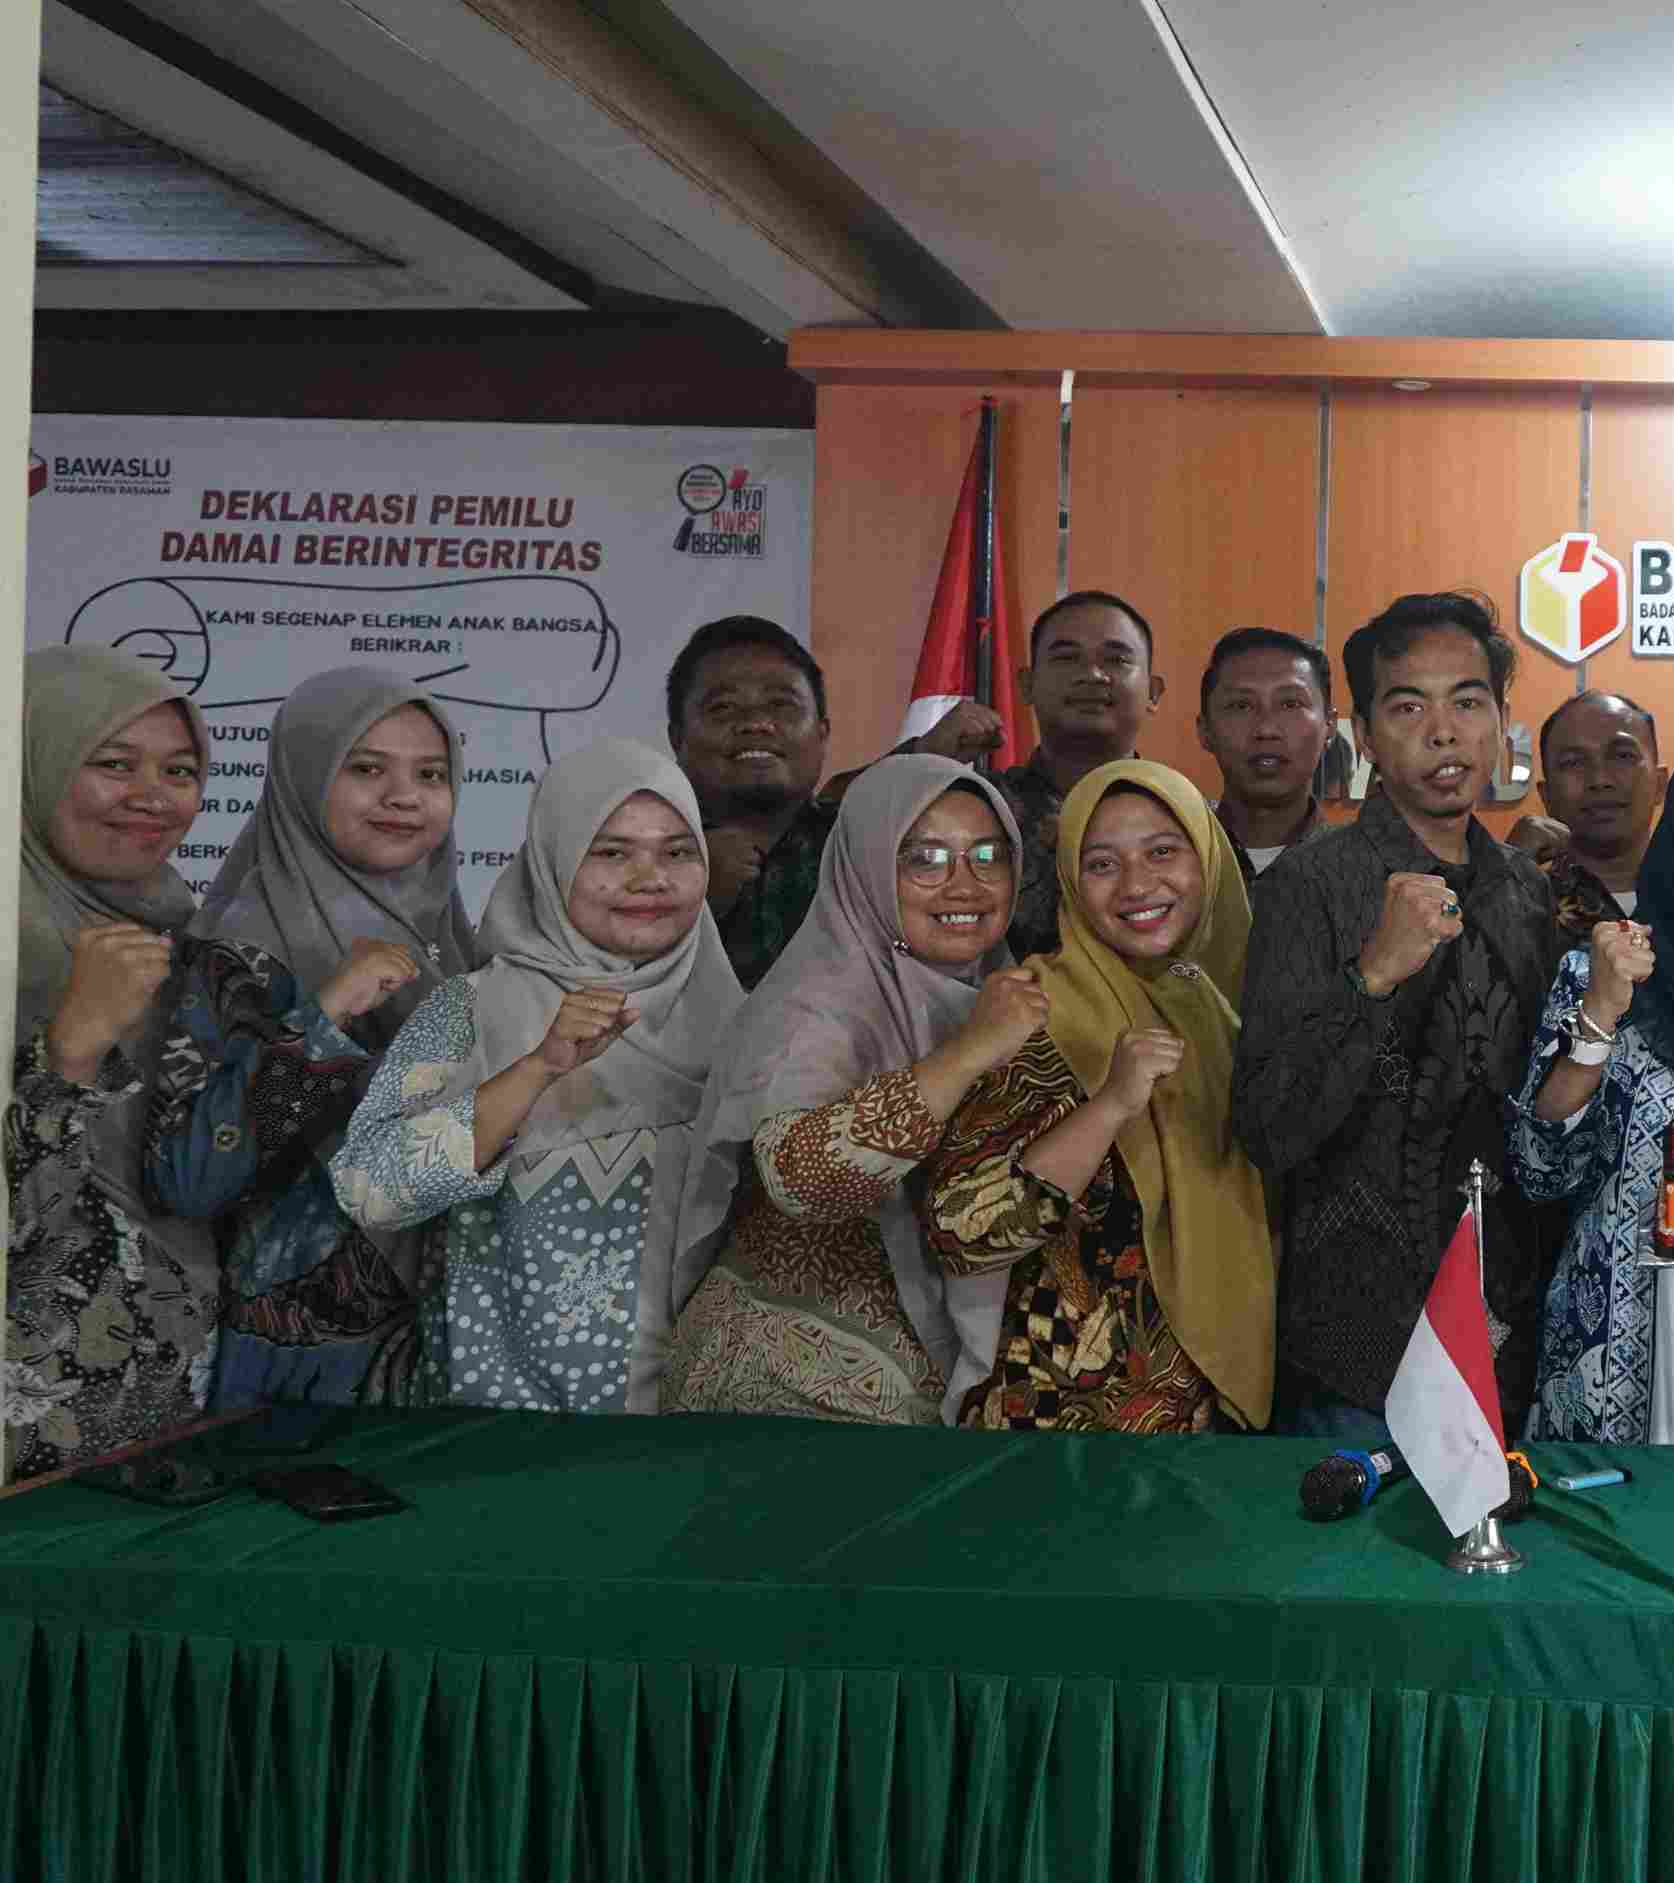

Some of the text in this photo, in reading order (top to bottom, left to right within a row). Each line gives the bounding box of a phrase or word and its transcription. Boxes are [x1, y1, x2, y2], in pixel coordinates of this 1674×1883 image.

[54, 457, 171, 477] BAWASLU
[200, 489, 575, 528] DEKLARASI PEMILU
[733, 488, 762, 511] AYO
[711, 511, 762, 533] AWASI
[160, 531, 603, 572] DAMAI BERINTEGRITAS
[692, 533, 761, 555] BERSAMA
[205, 610, 255, 625] KAMI
[262, 611, 356, 628] SEGENAP
[362, 613, 442, 629] ELEMEN
[448, 616, 504, 631] ANAK
[350, 637, 450, 654] BERIKRAR
[208, 726, 271, 742] UJUD
